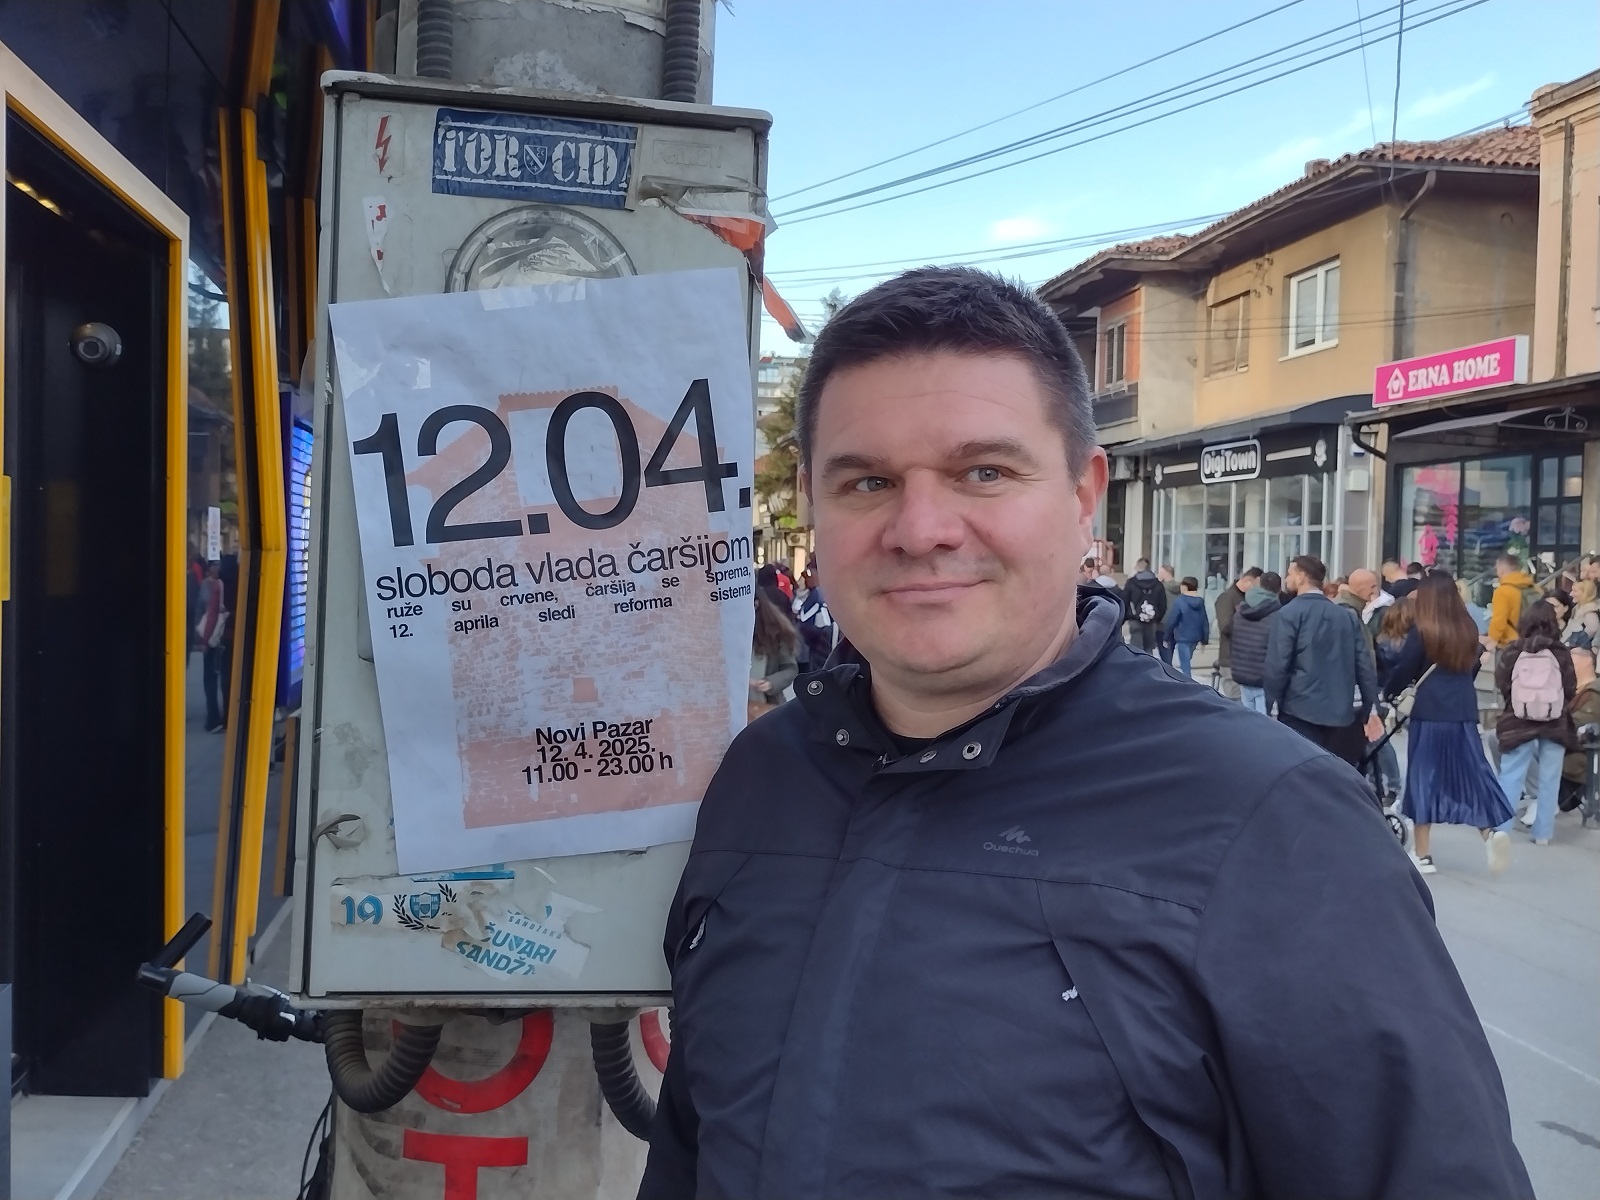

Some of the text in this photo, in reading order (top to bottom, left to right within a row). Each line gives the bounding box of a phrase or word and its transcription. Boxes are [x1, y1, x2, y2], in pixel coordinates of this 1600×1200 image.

[1407, 352, 1500, 392] ERNA HOME
[353, 378, 751, 547] 12.04.
[1203, 450, 1256, 478] DigiTown
[376, 534, 750, 601] sloboda vlada čaršijom
[387, 565, 751, 618] ruže su crvene, čaršija se sprema,
[389, 584, 751, 638] 12. aprila sledi reforma sistema
[535, 718, 653, 746] Novi Pazar
[537, 735, 656, 763] 12. 4. 2025.
[522, 762, 579, 785] 11.00
[597, 754, 655, 777] 23.00
[659, 752, 673, 770] h
[341, 895, 383, 925] 19
